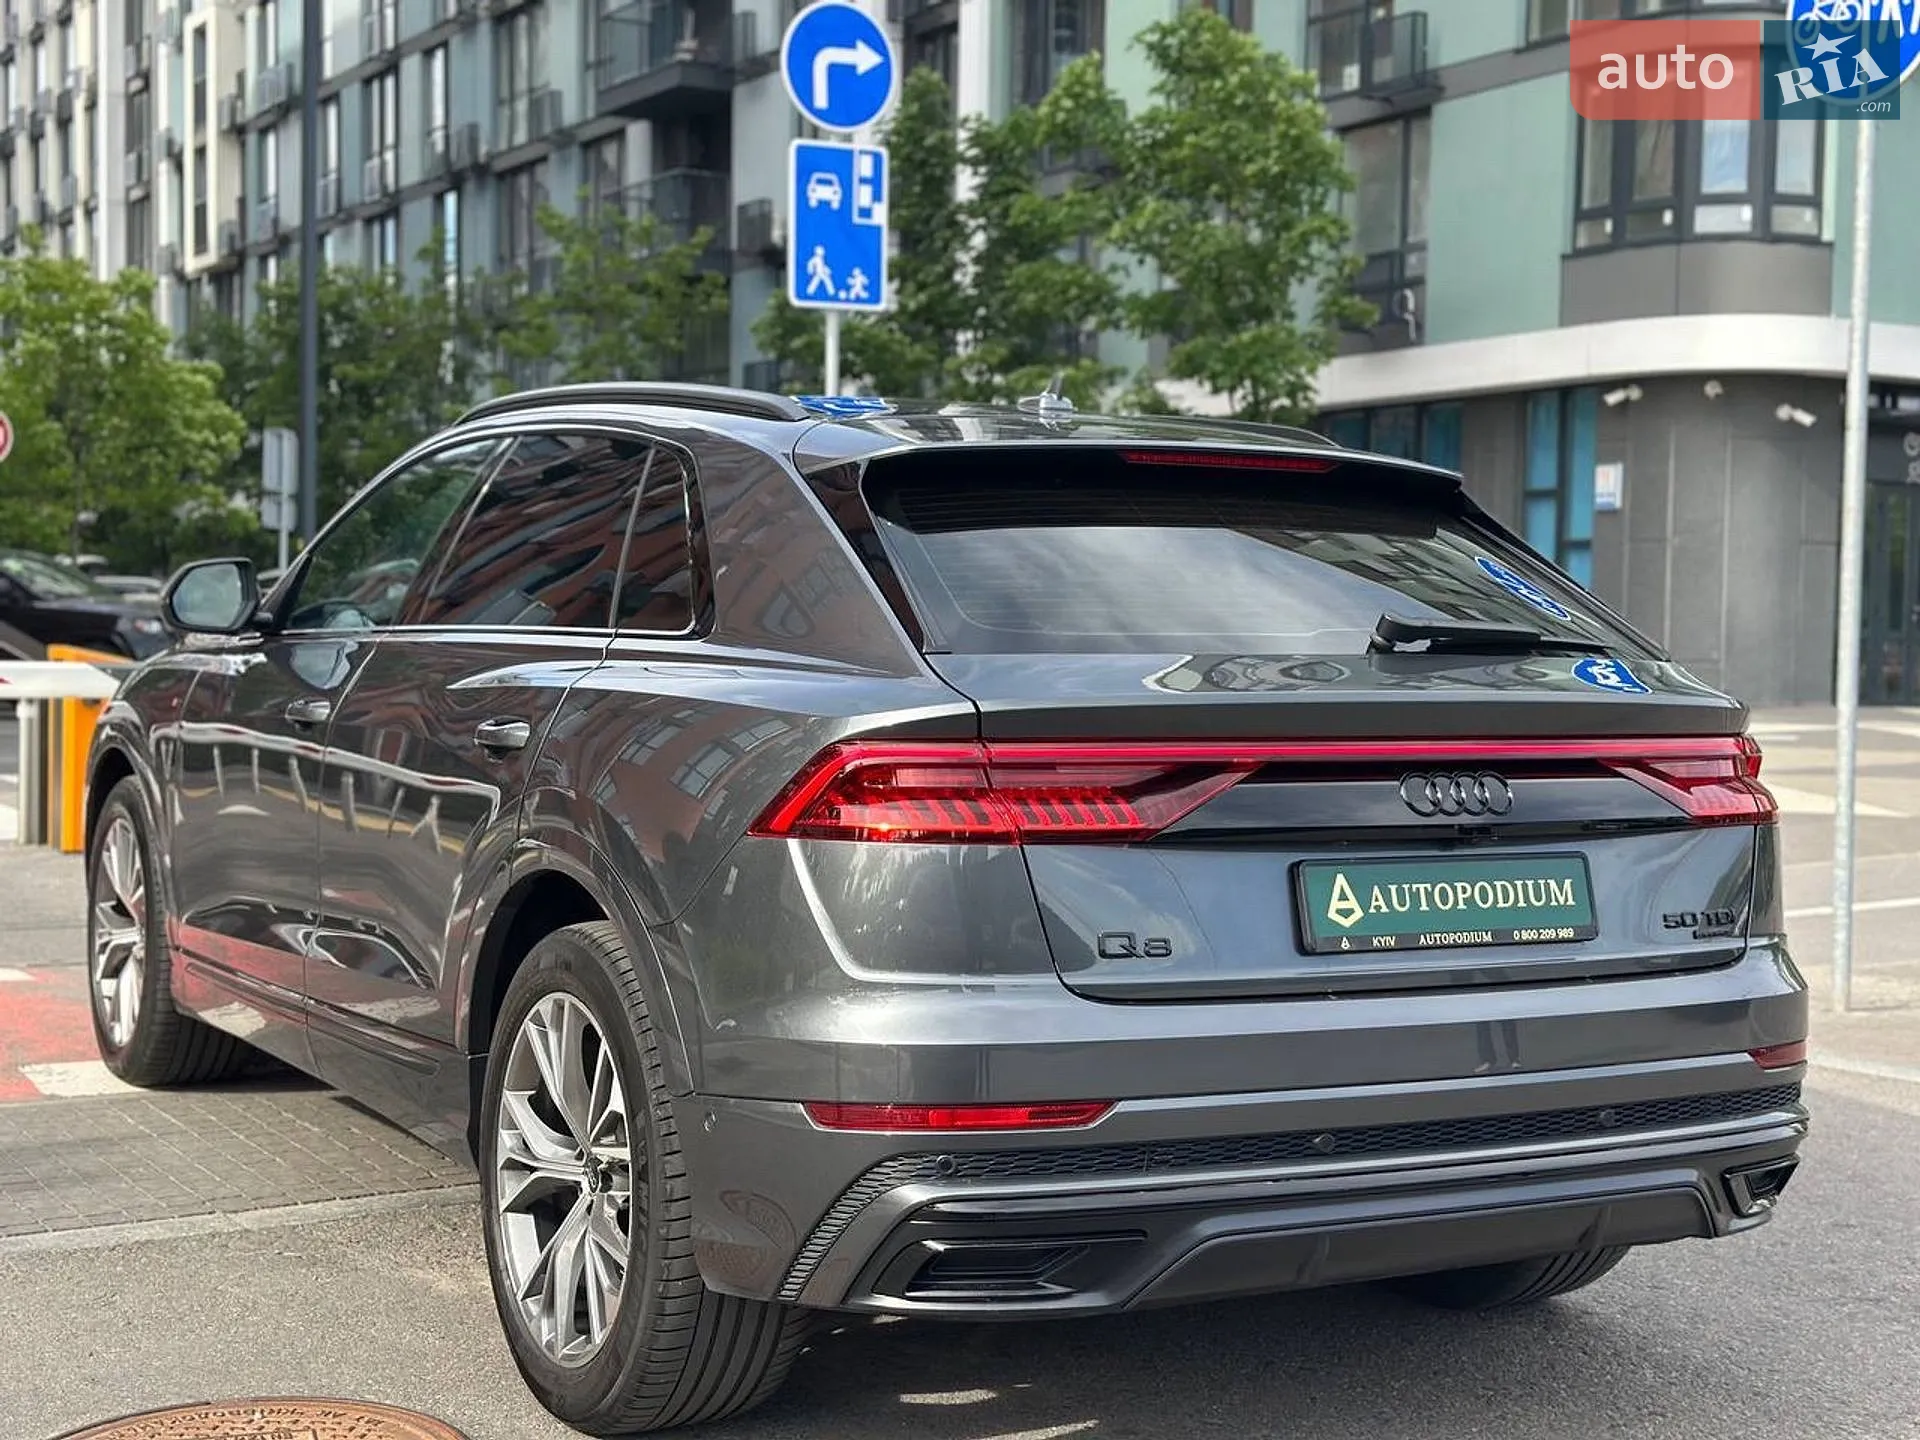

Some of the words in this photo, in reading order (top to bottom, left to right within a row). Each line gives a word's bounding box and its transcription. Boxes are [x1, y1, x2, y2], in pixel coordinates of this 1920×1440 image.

[1368, 879, 1576, 913] AUTOPODIUM
[1662, 911, 1699, 929] 50
[1097, 931, 1172, 959] Q8
[1372, 935, 1396, 948] KYIV
[1419, 931, 1493, 945] AUTOPODIUM
[1513, 930, 1520, 940] 0
[1521, 929, 1539, 940] 800
[1540, 928, 1556, 939] 209
